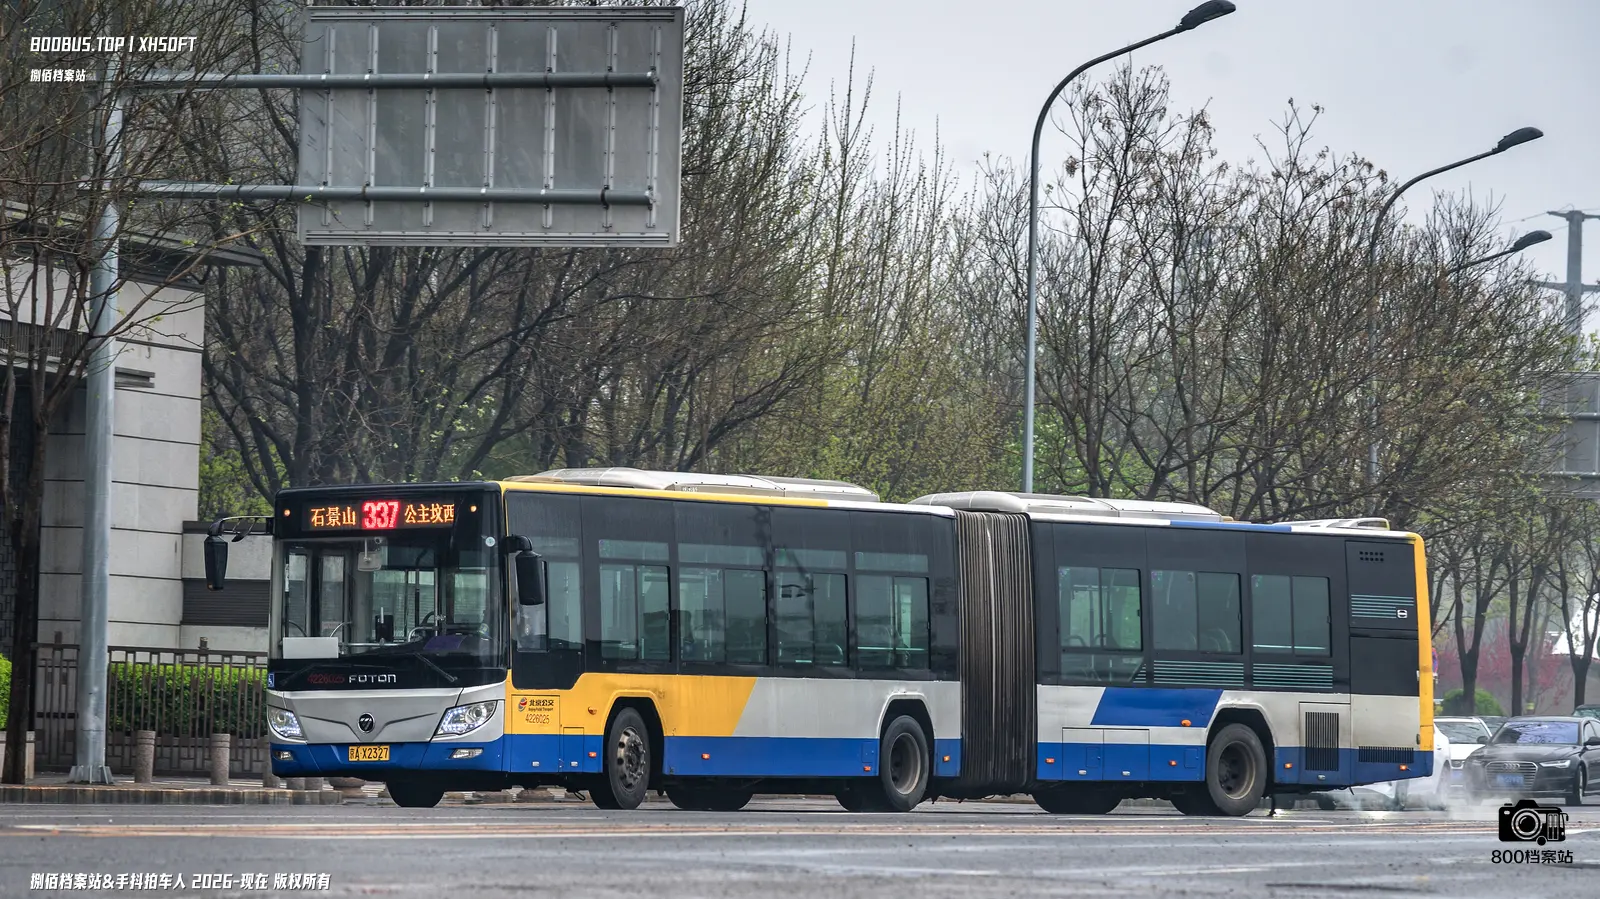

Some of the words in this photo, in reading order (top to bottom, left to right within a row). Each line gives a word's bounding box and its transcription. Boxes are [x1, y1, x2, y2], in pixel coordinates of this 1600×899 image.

[310, 506, 357, 527] 石景山
[362, 501, 400, 529] 337
[404, 503, 455, 524] 公主坟西
[349, 674, 397, 684] FOTON
[529, 699, 554, 707] 北京公交
[525, 713, 550, 724] 4226025
